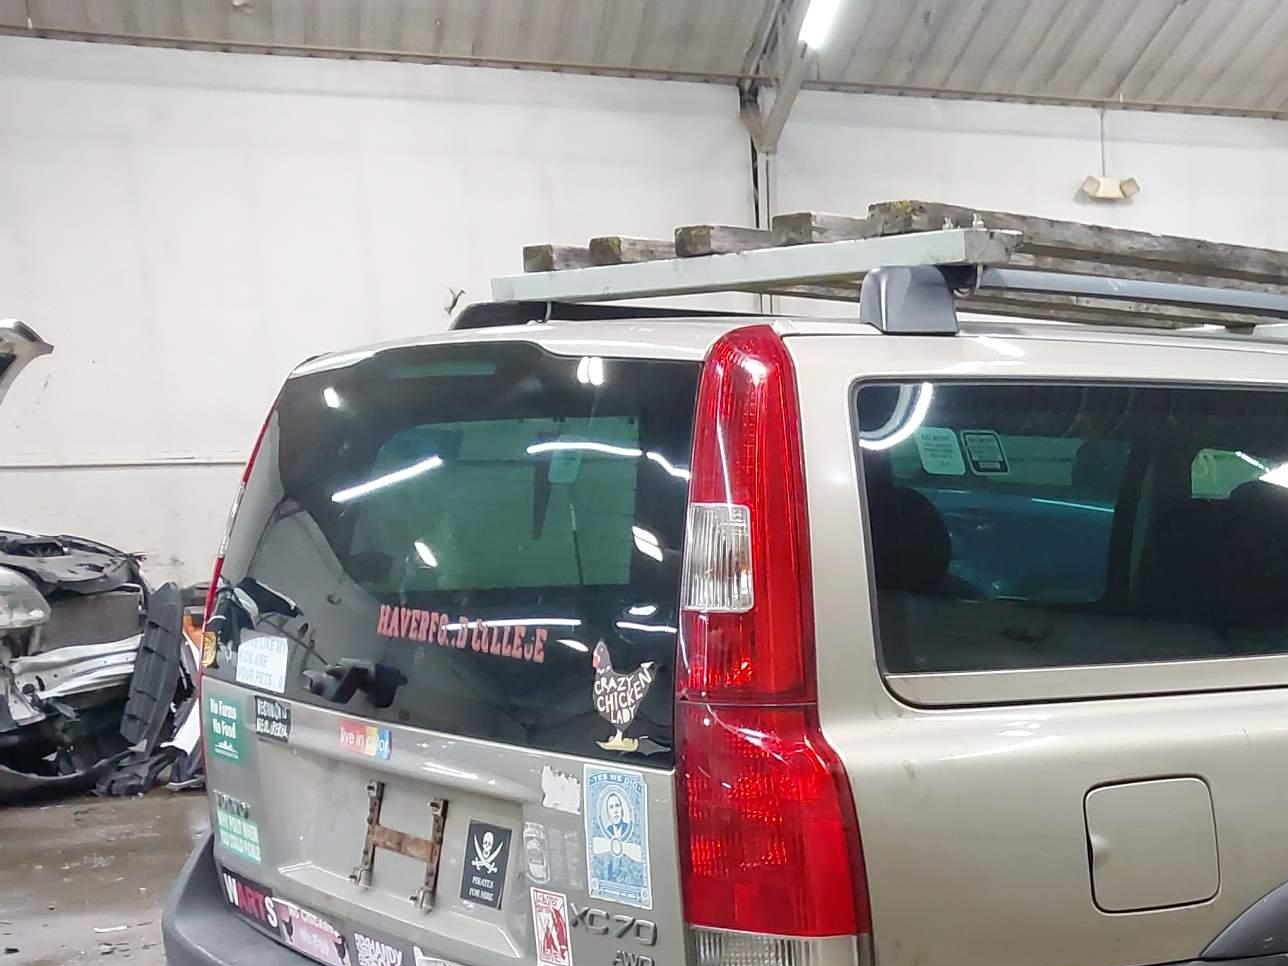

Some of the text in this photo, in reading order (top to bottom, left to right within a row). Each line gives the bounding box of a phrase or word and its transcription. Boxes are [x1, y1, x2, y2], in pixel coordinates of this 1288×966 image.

[594, 675, 635, 695] CRAZY
[597, 668, 652, 713] CHICKEN
[210, 697, 218, 715] No
[219, 700, 236, 721] Farms
[610, 705, 636, 724] LADY
[212, 717, 221, 735] No
[222, 720, 236, 739] Food
[593, 773, 608, 783] YES
[472, 875, 494, 889] PIRATES
[469, 887, 480, 898] FOR
